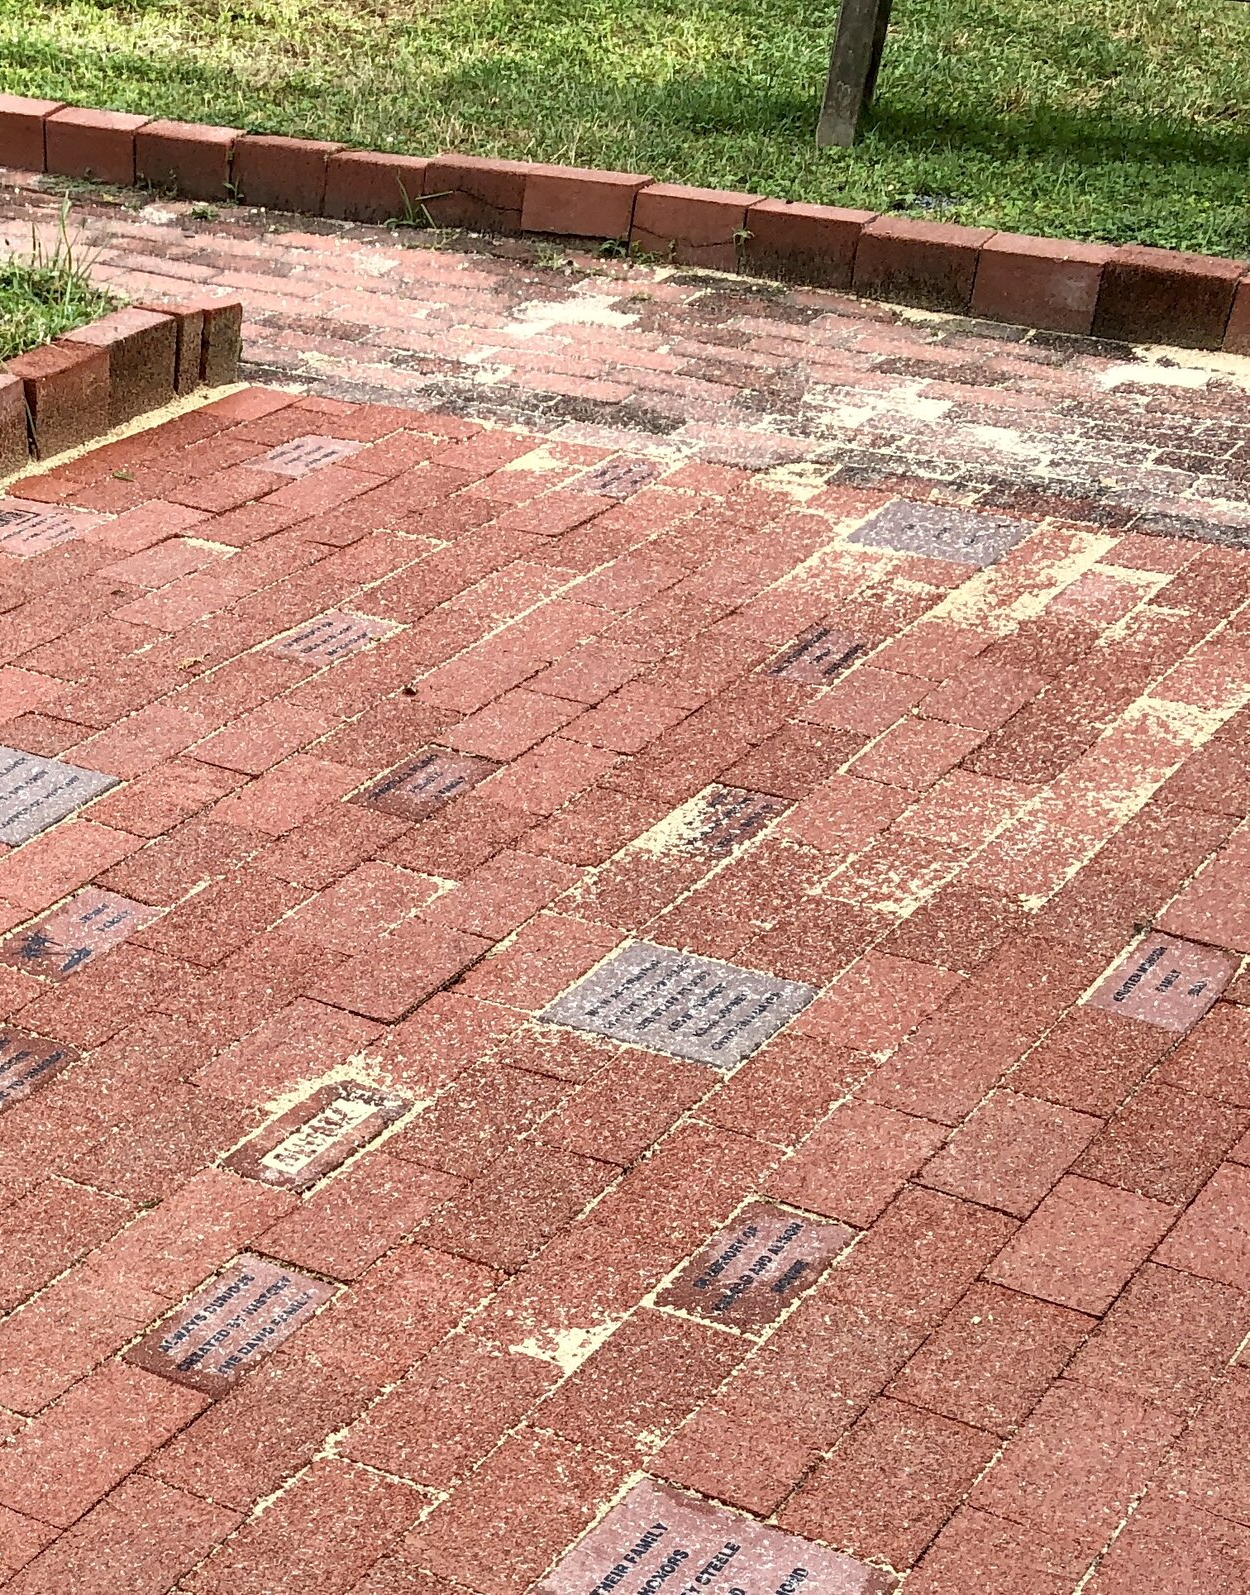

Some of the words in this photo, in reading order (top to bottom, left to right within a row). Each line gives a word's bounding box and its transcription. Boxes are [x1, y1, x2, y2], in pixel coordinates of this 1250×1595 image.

[1156, 968, 1180, 993] FAMILY
[7, 1078, 25, 1090] TO
[748, 1254, 772, 1274] AND
[158, 1313, 207, 1352] ALWAYS
[217, 1355, 240, 1374] THE
[271, 1292, 312, 1326] FAMILY
[227, 1315, 245, 1328] BY
[624, 1523, 668, 1564] FAMILY
[695, 1541, 741, 1585] STEELE
[637, 1550, 689, 1595] HONORS
